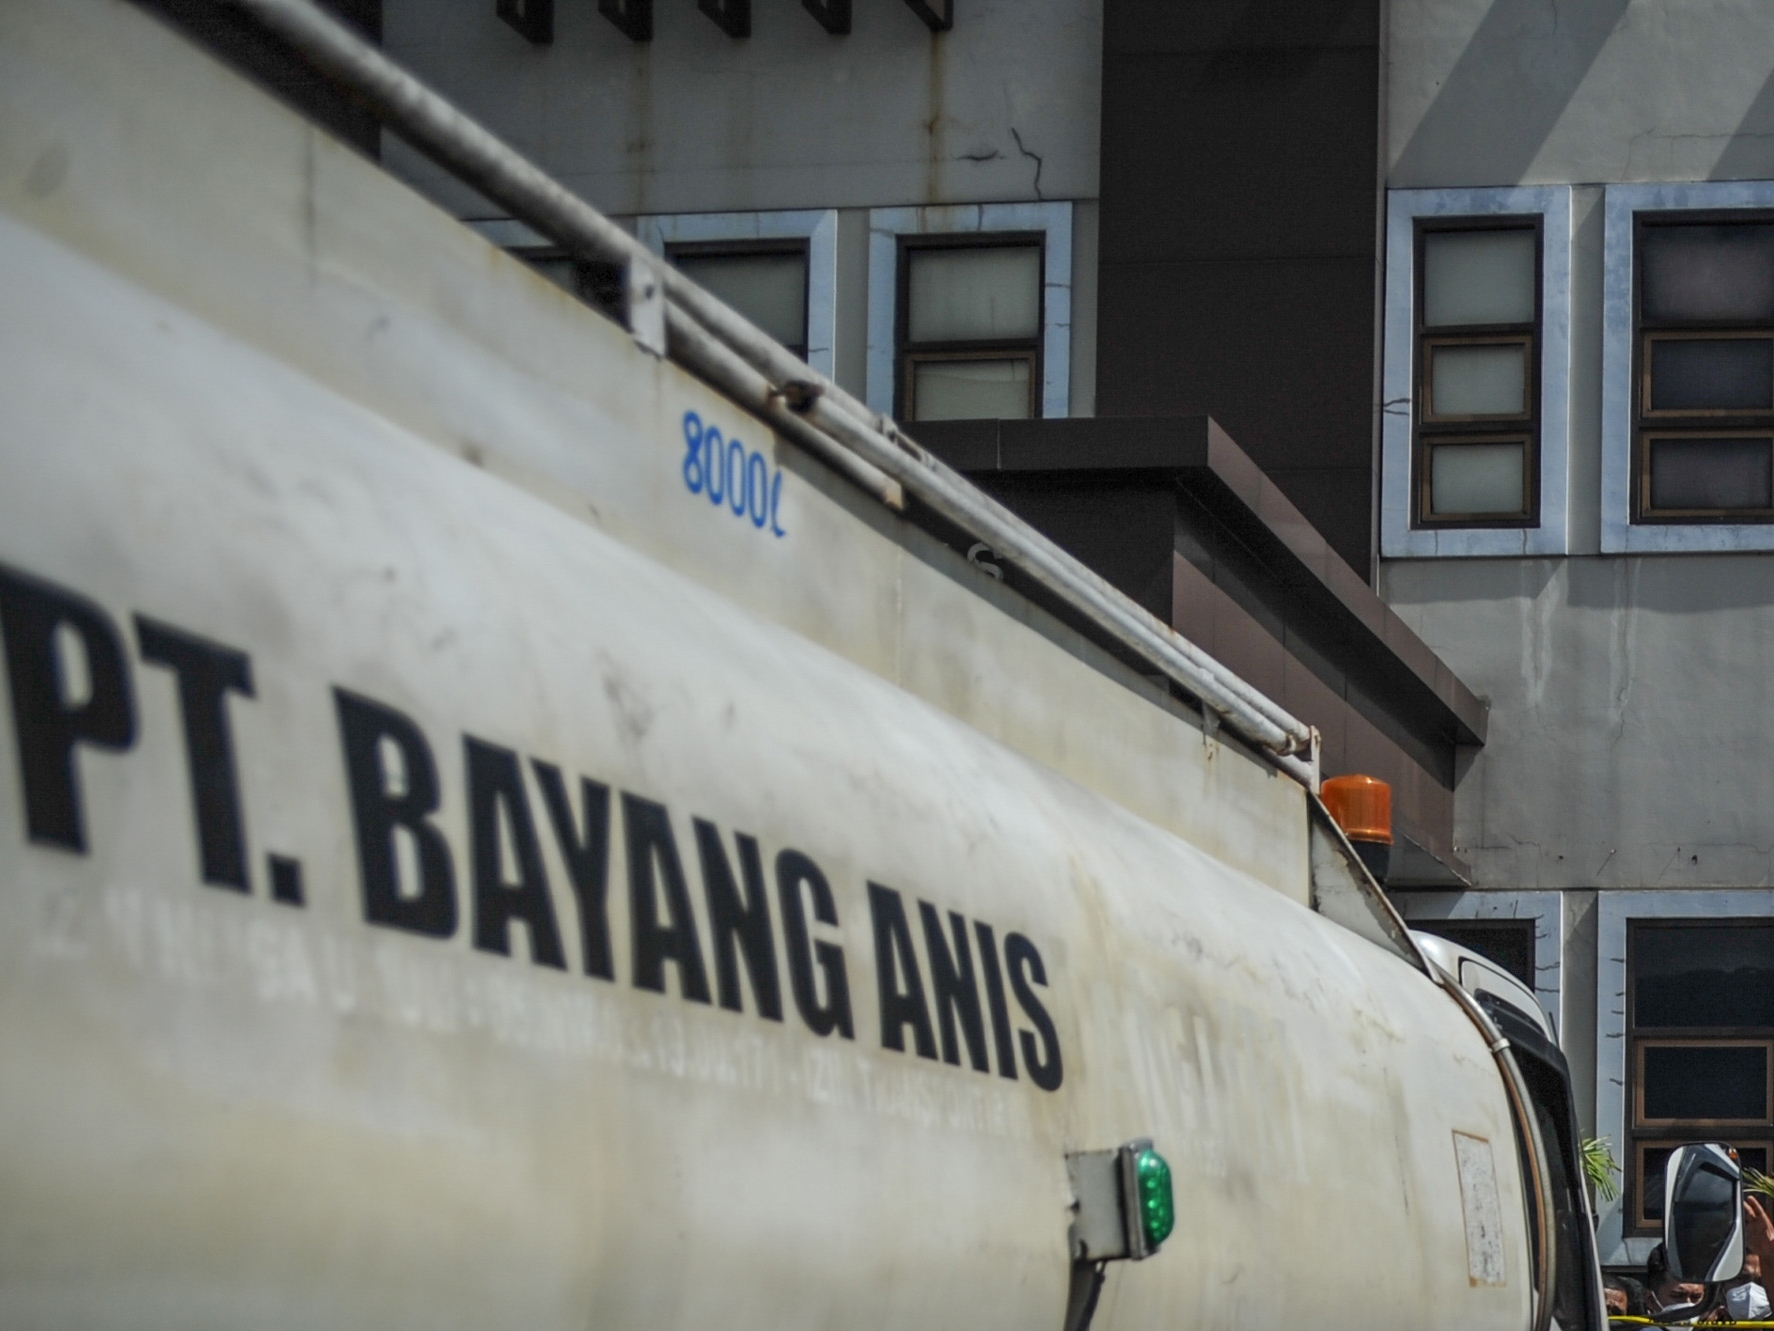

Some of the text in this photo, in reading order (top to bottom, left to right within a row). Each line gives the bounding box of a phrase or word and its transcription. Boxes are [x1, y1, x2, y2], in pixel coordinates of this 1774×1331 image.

[0, 561, 1066, 1092] PT. BAYANG ANIS
